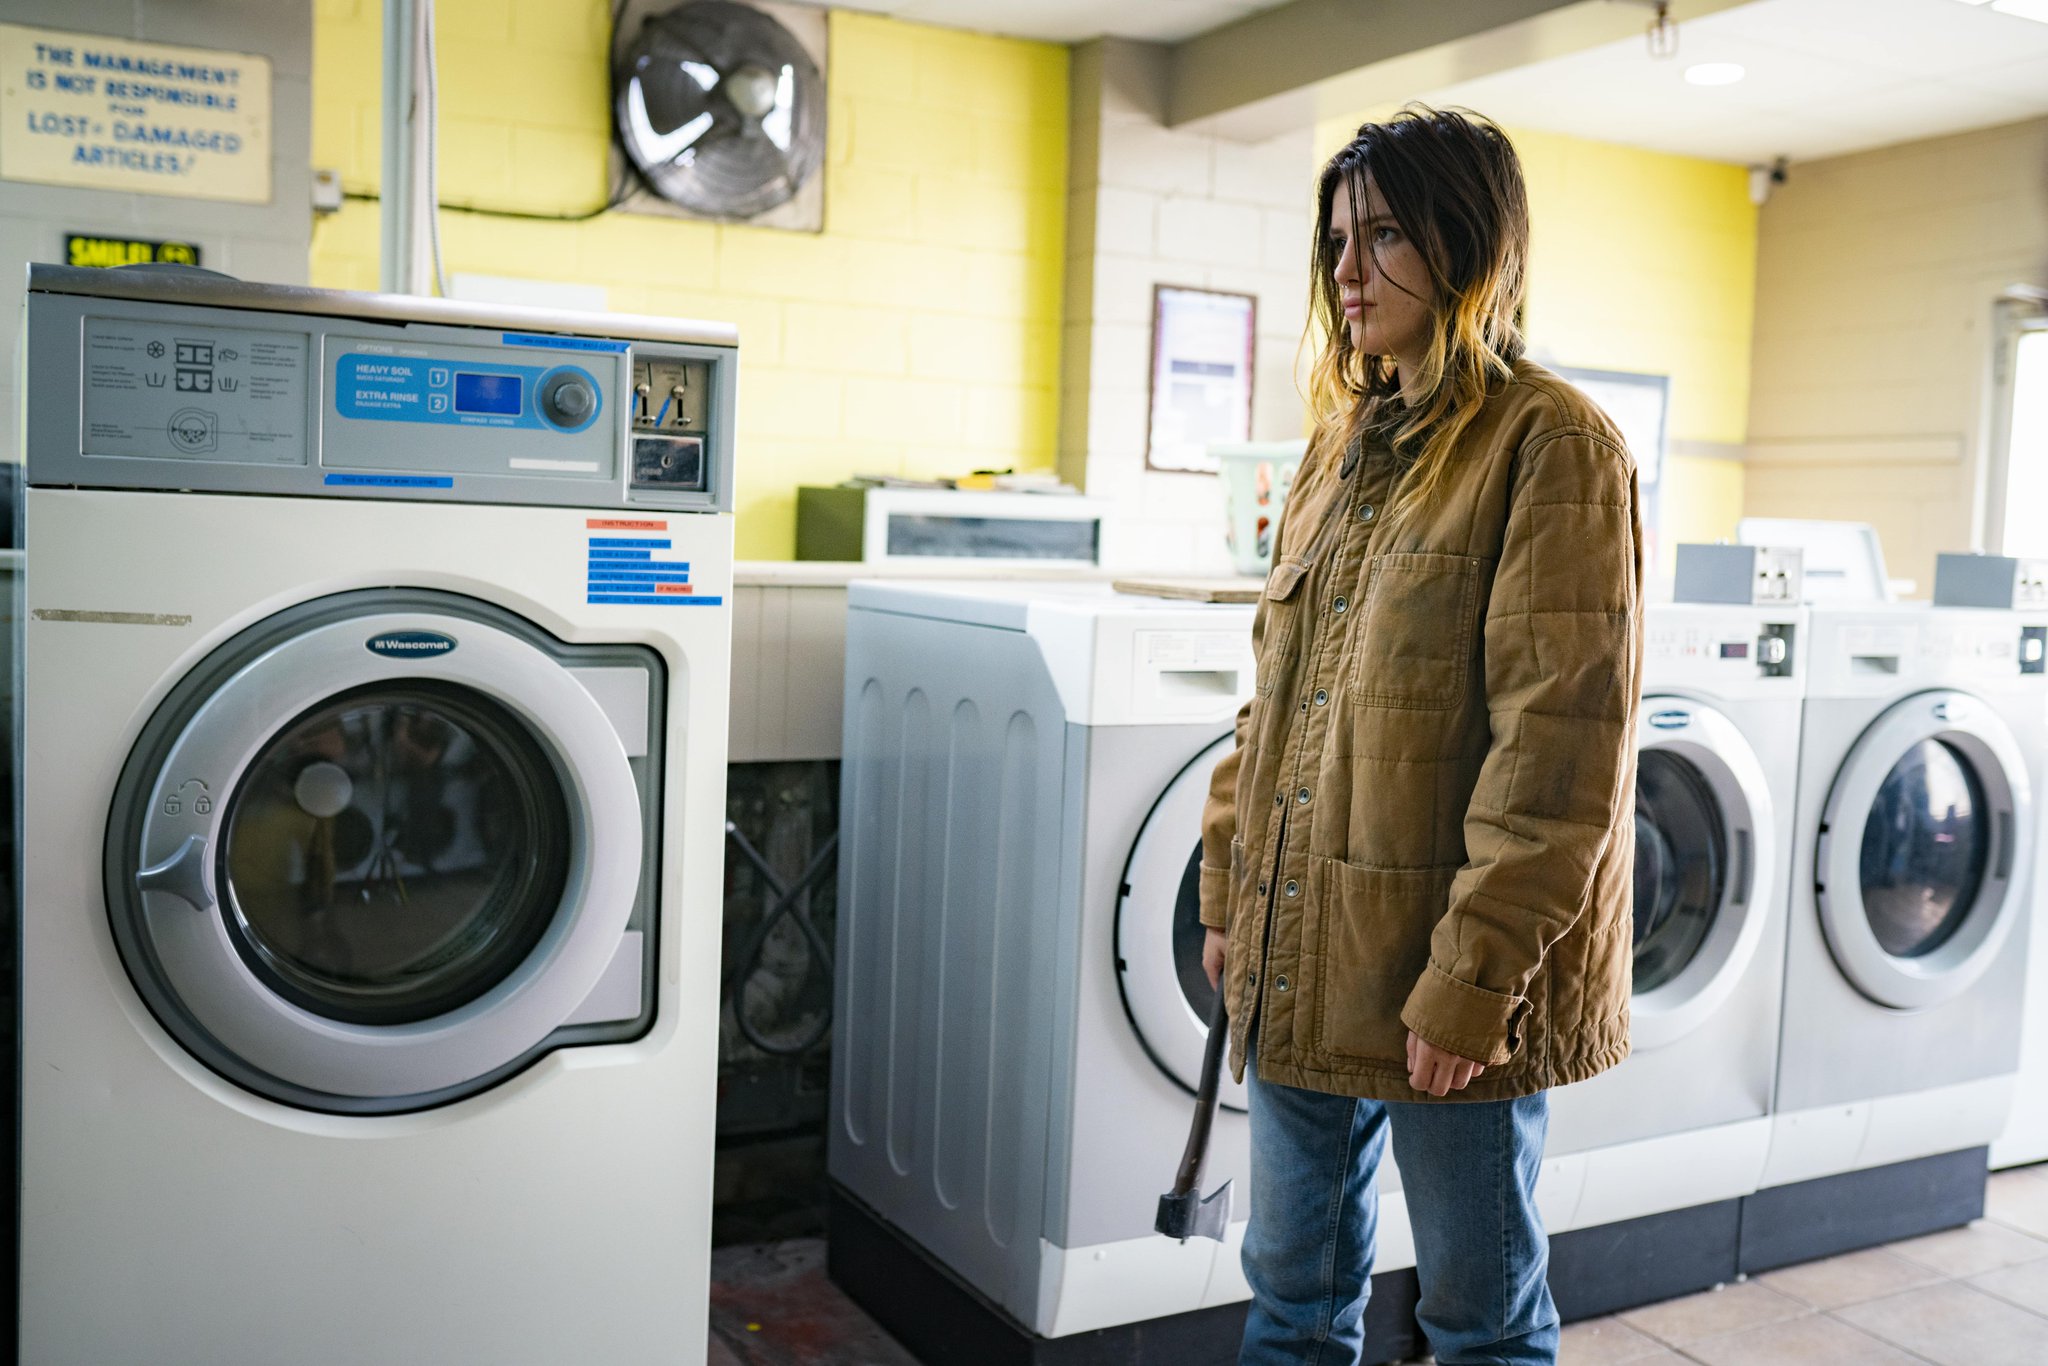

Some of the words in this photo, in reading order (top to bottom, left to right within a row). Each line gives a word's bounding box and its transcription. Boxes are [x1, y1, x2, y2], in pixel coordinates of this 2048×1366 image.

[35, 45, 73, 66] THE
[84, 53, 239, 86] MANAGEMENT
[26, 70, 47, 90] IS
[54, 73, 96, 95] NOT
[106, 81, 237, 110] RESPONSIBLE
[28, 111, 88, 136] LOST
[114, 121, 241, 153] DAMAGED
[356, 344, 393, 354] OPTIONS
[356, 365, 389, 375] HEAVY
[391, 367, 414, 376] SOIL
[434, 373, 441, 384] 1
[356, 390, 388, 401] EXTRA
[389, 392, 419, 403] RINSE
[434, 399, 442, 409] 2
[386, 640, 450, 649] Wascomat
